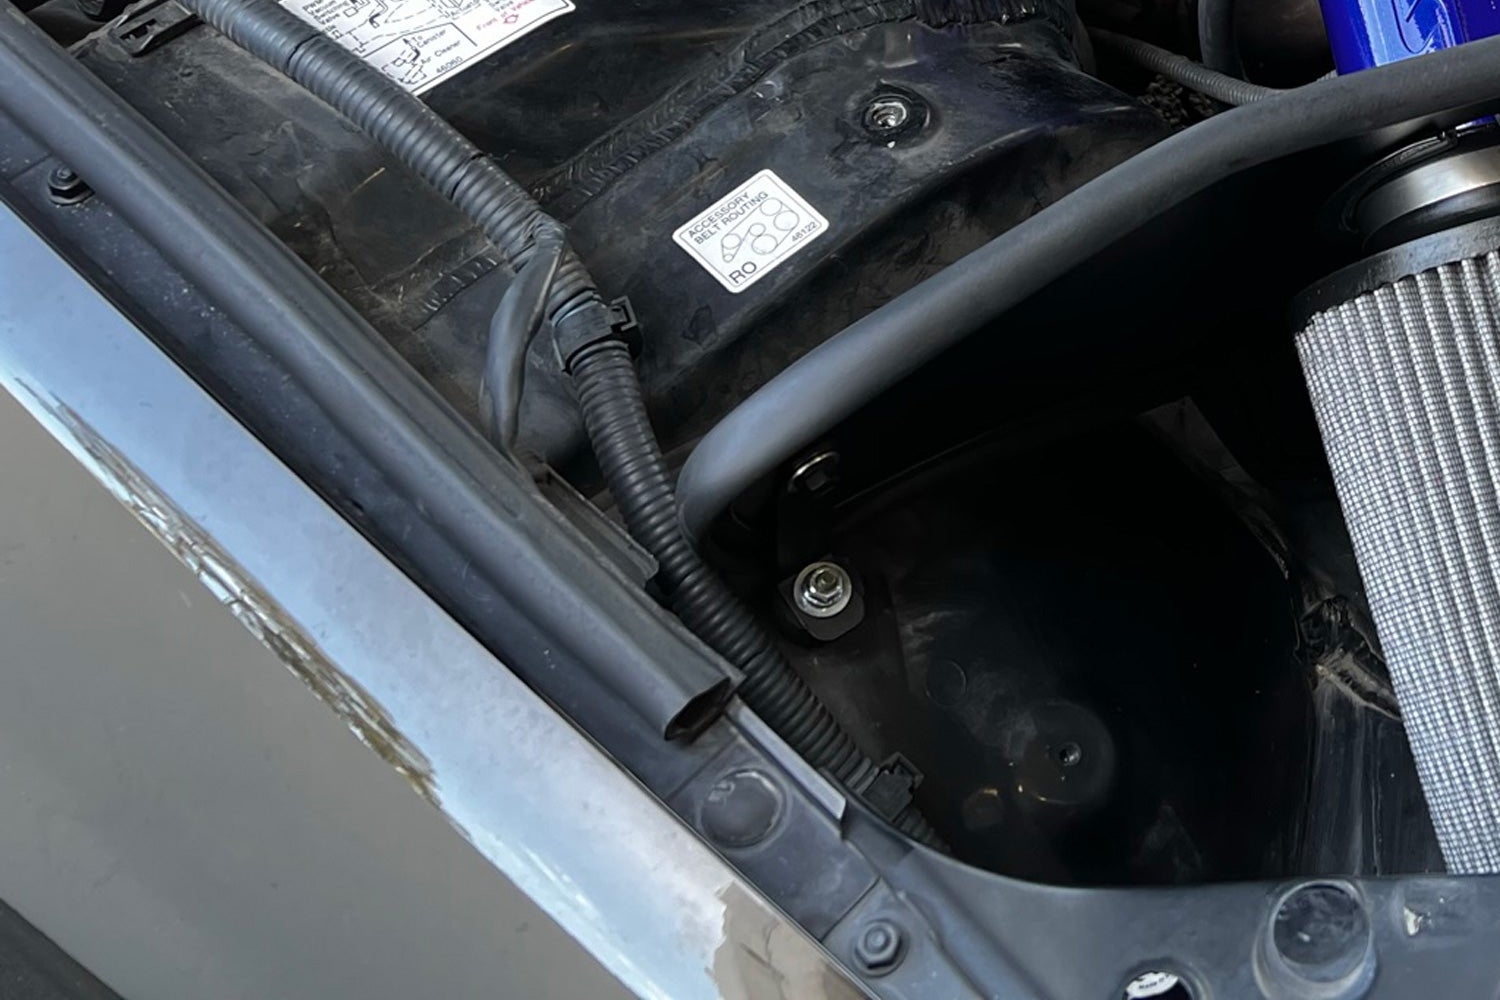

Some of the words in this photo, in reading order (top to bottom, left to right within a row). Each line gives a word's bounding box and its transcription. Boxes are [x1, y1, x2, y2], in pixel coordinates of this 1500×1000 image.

[688, 192, 750, 239] ACCESSORY
[693, 223, 722, 245] BELT
[722, 190, 769, 226] ROUTING
[728, 261, 757, 284] RO
